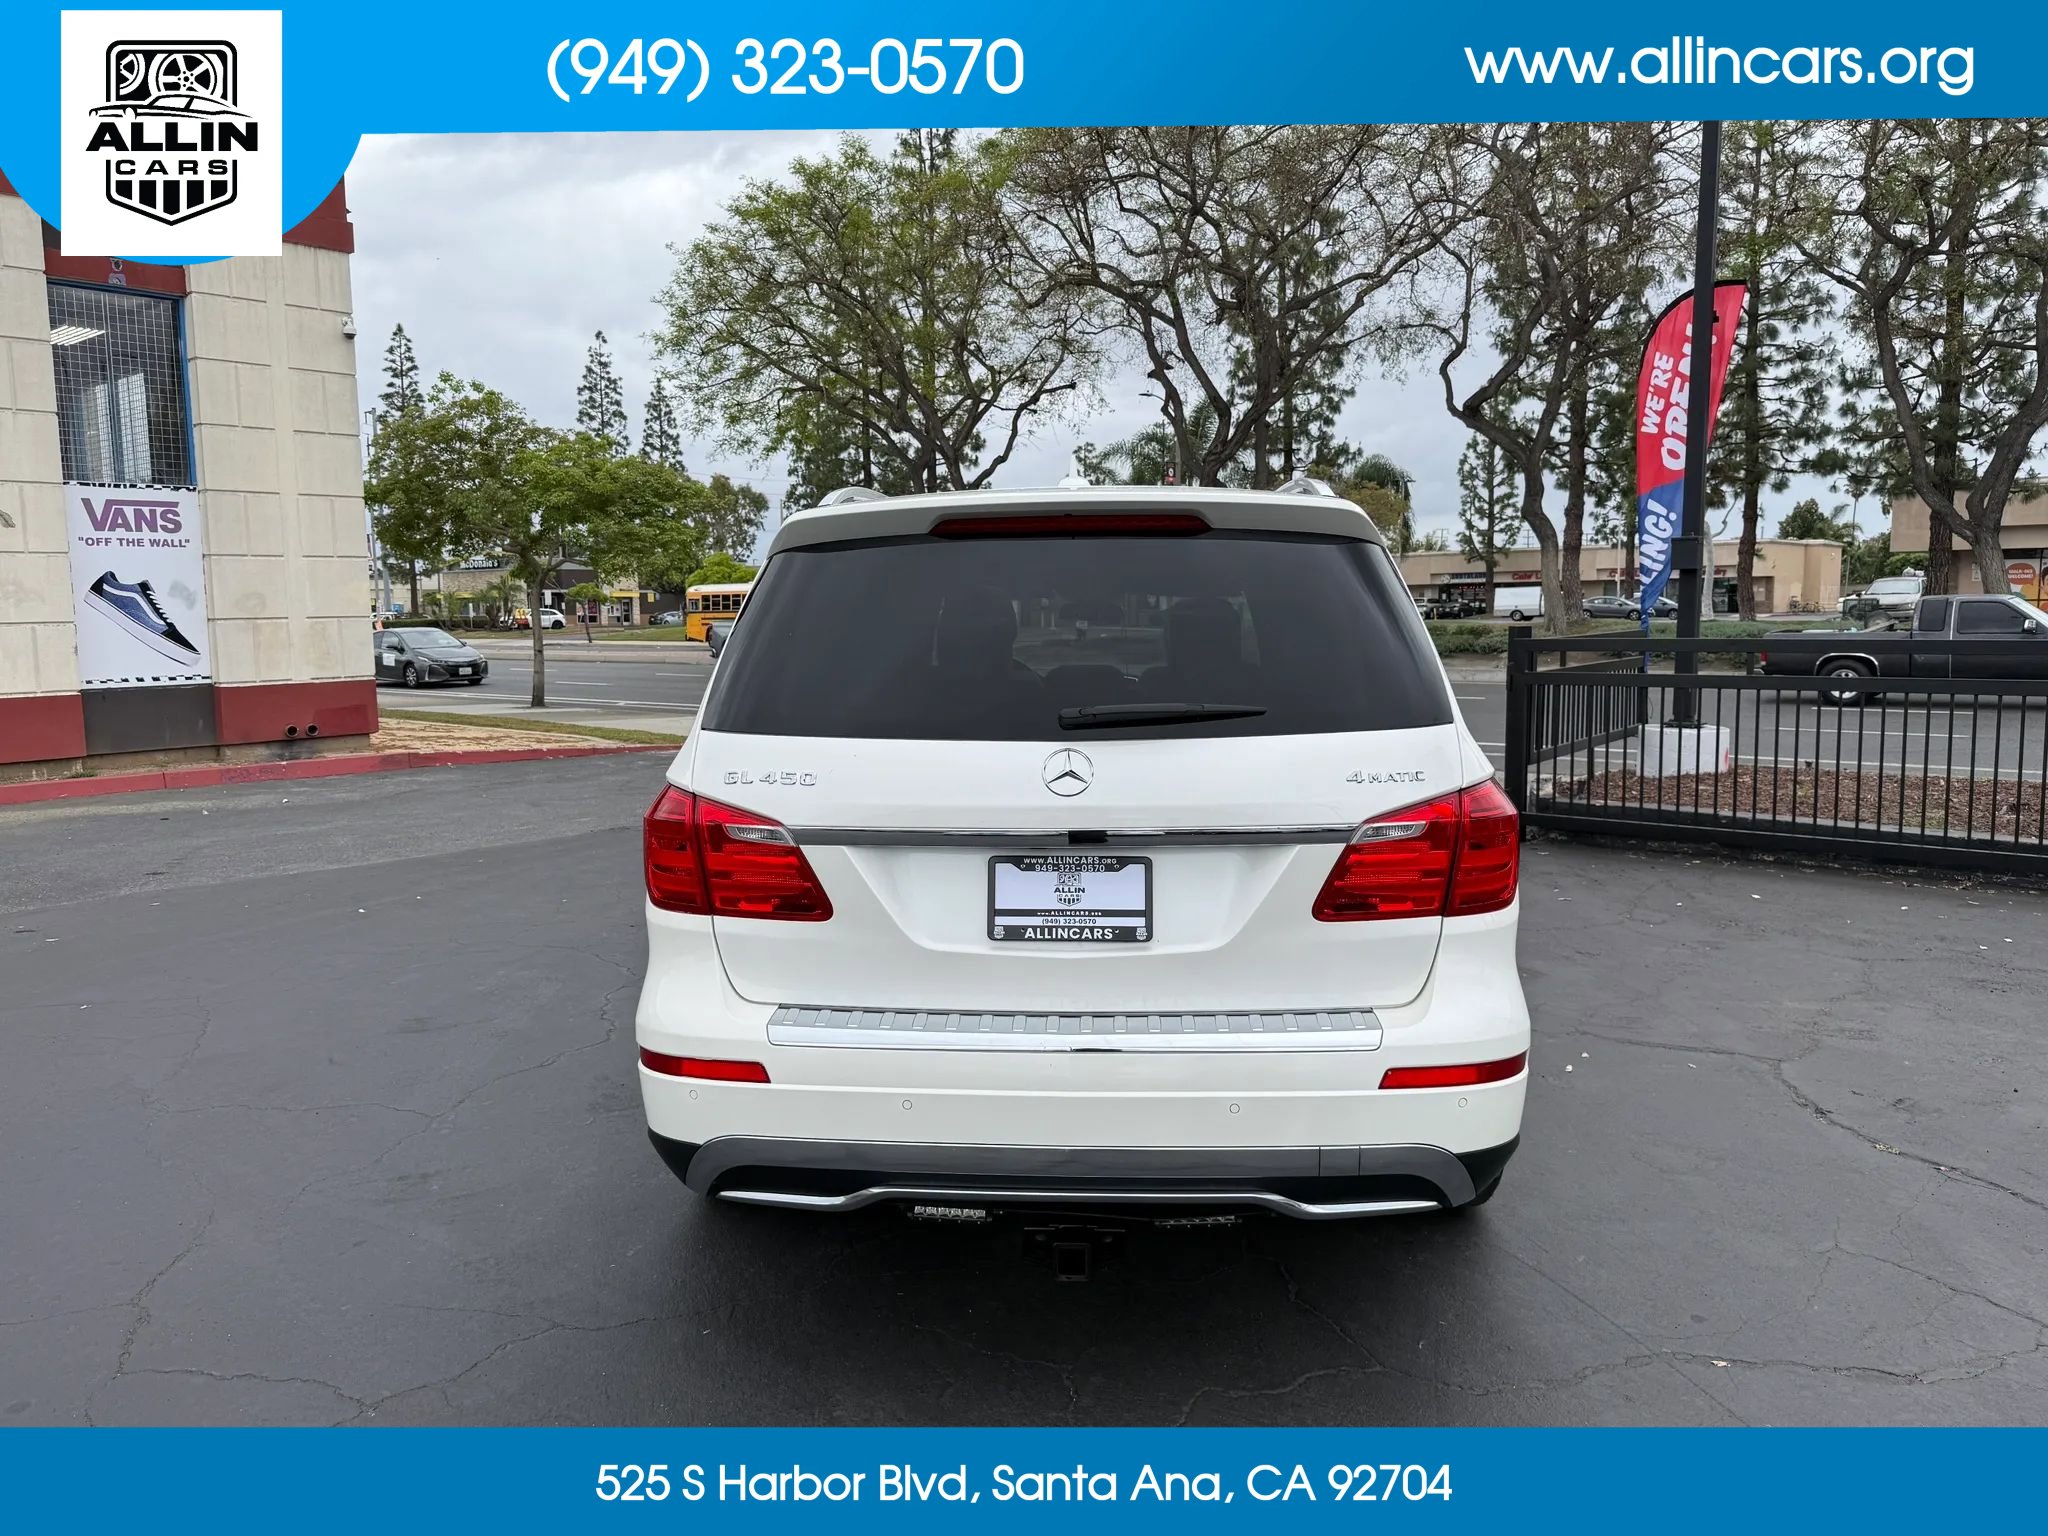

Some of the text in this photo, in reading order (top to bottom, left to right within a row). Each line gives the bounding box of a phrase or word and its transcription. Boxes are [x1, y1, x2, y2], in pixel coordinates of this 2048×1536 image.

[1640, 351, 1674, 434] WE'RE
[81, 498, 183, 534] VANS
[78, 537, 190, 548] "OFF THE WALL"
[723, 770, 817, 786] GL 450
[1042, 918, 1061, 926] (949)
[1024, 927, 1113, 940] ALLINCARS
